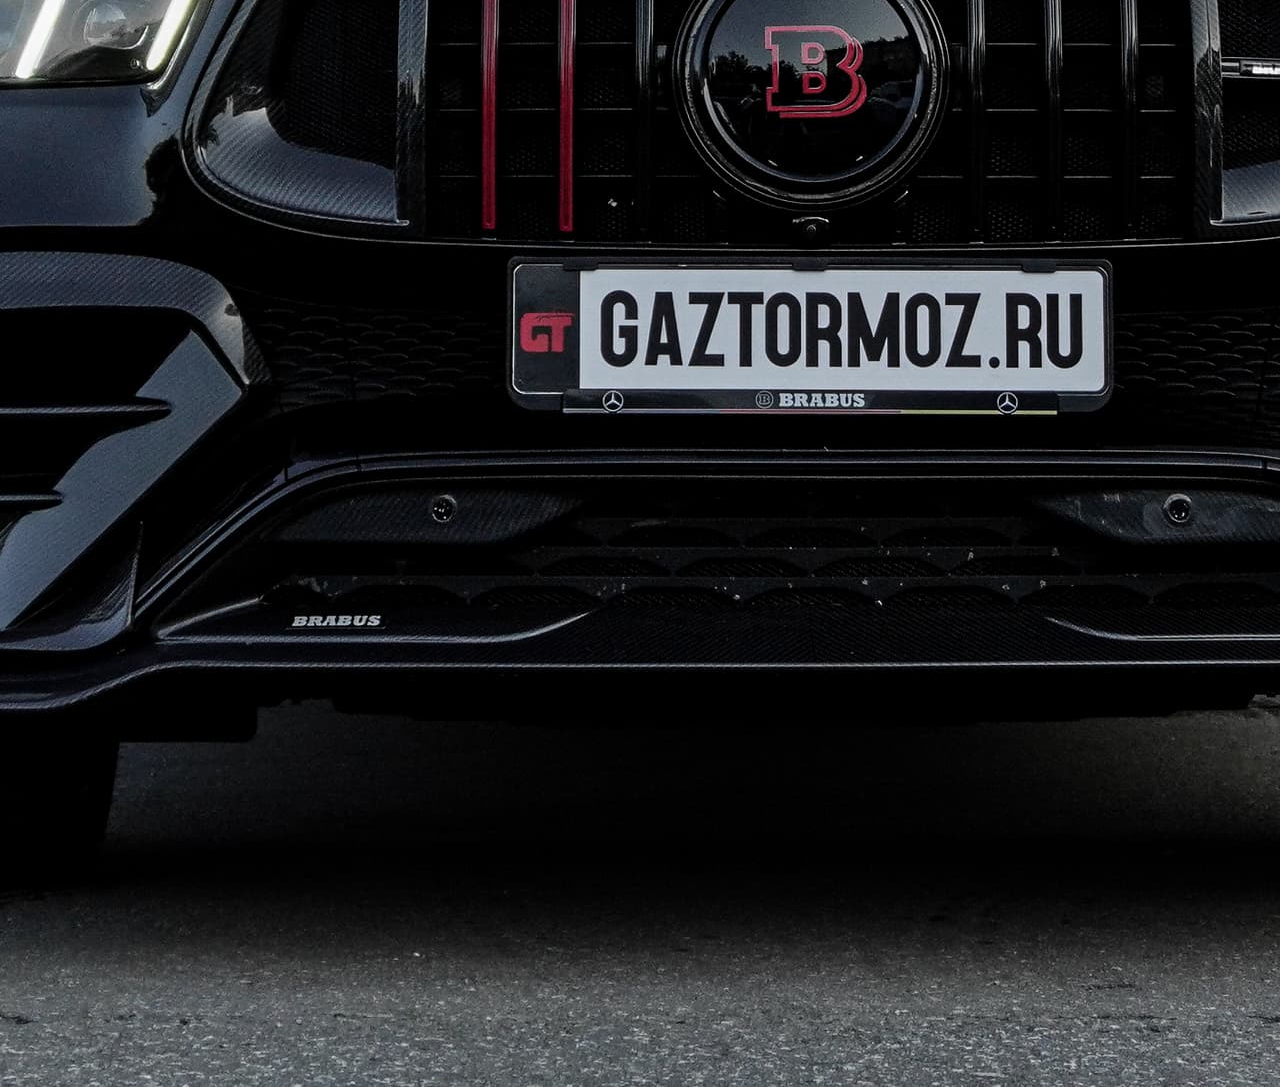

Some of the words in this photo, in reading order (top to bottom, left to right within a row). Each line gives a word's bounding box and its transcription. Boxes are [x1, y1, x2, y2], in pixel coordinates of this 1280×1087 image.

[520, 312, 573, 353] GT
[599, 290, 1083, 369] GAZTORMOZ.RU
[779, 392, 865, 408] BRABUS
[291, 615, 382, 627] BRABUS
